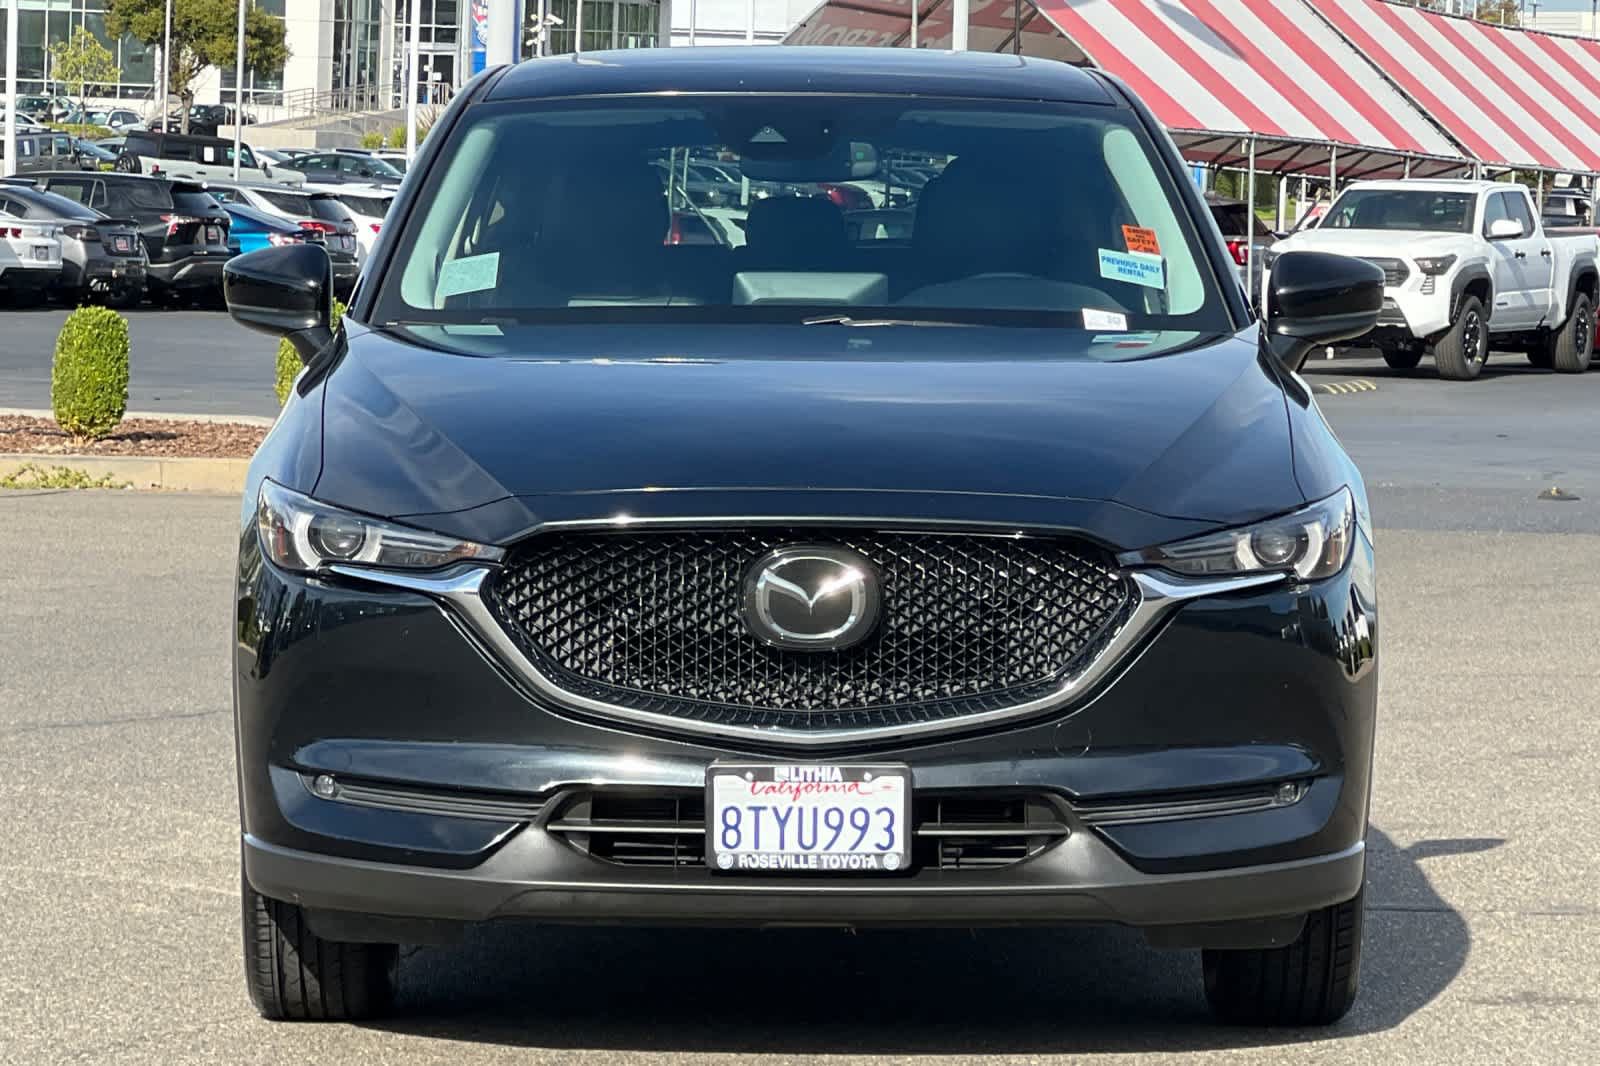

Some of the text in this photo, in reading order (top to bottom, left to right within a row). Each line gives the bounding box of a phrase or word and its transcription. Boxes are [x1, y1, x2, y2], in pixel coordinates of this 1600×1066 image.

[1101, 256, 1160, 272] PREVIOUS DAILY
[1117, 267, 1144, 277] RENTAL
[790, 766, 843, 782] LITHIA
[721, 805, 895, 852] 8TYU993
[739, 854, 877, 869] ROSEVILLE TOYOTA
